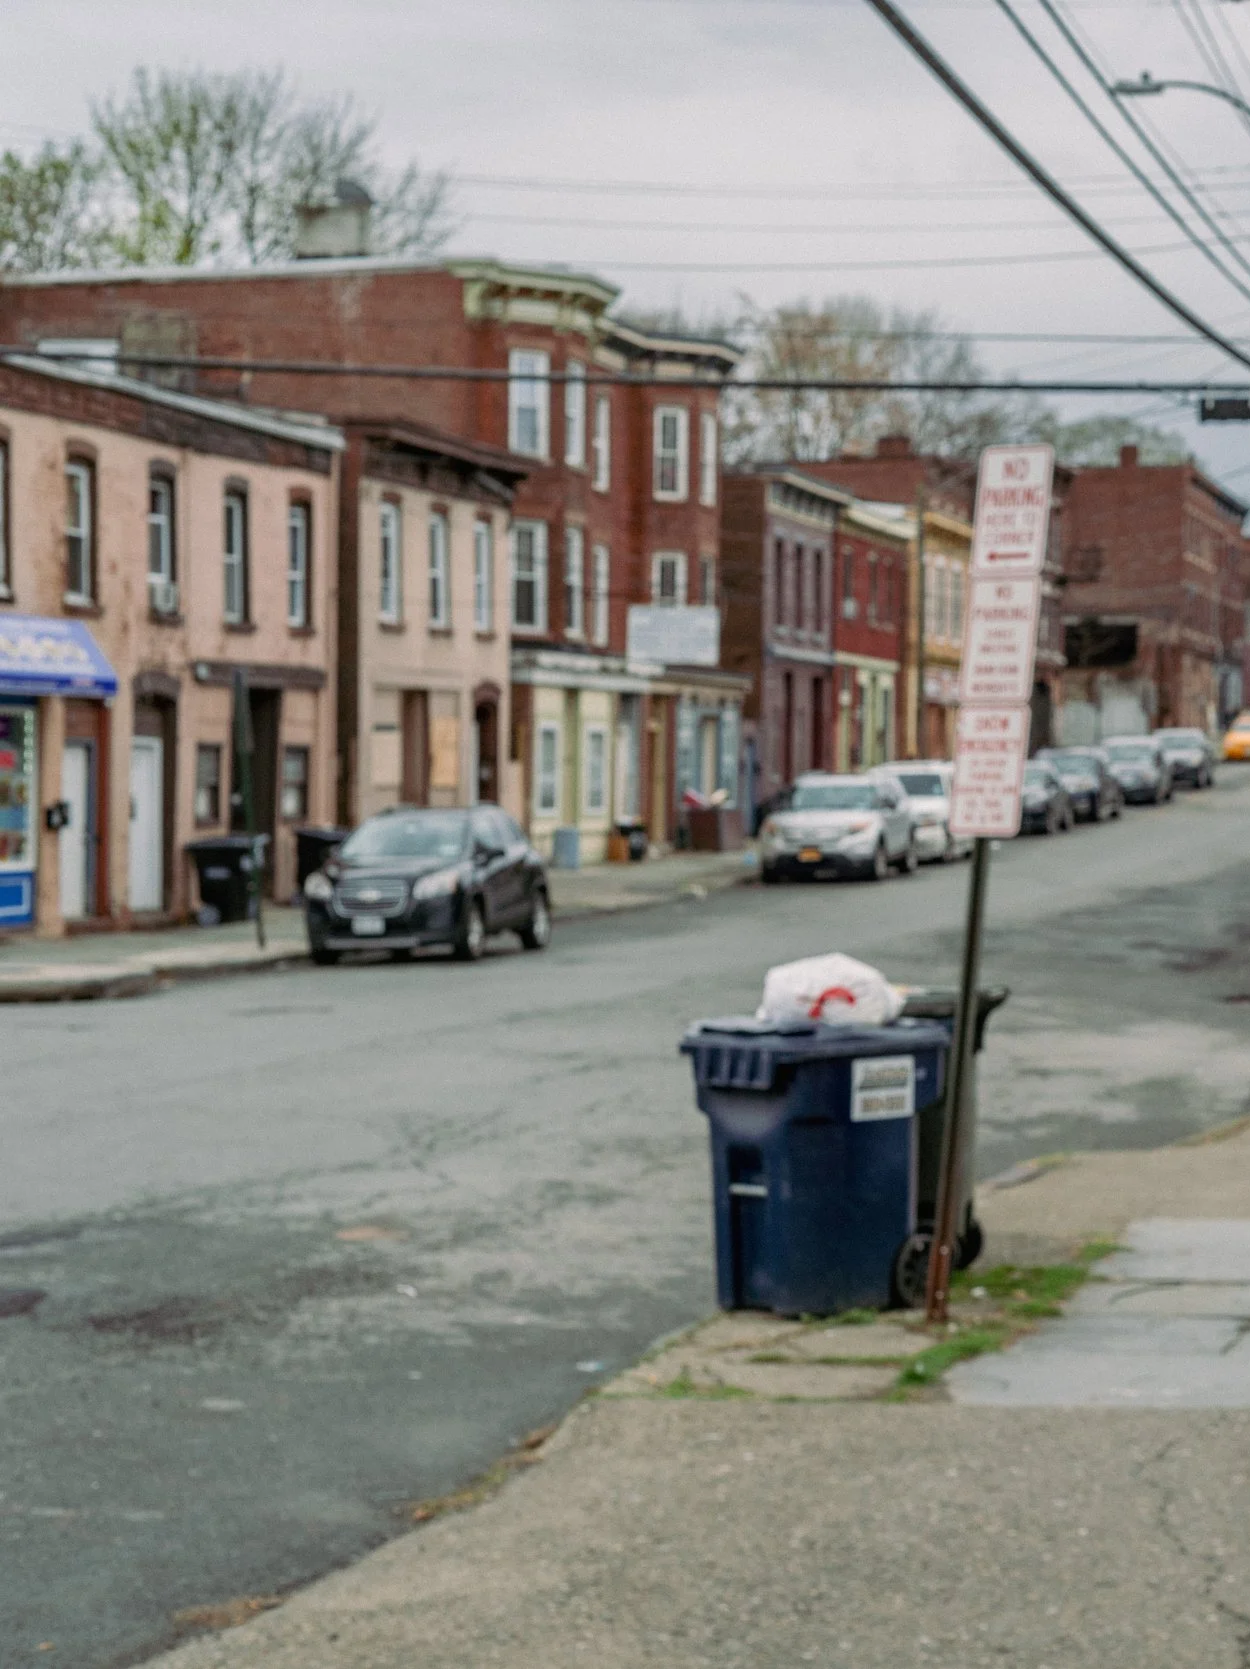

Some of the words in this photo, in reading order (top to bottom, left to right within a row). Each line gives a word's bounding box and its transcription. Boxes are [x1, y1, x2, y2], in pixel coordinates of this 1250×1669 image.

[1002, 458, 1030, 481] NO
[981, 487, 1045, 507] PARKING
[995, 584, 1013, 600] NO
[976, 606, 1030, 621] PARKING
